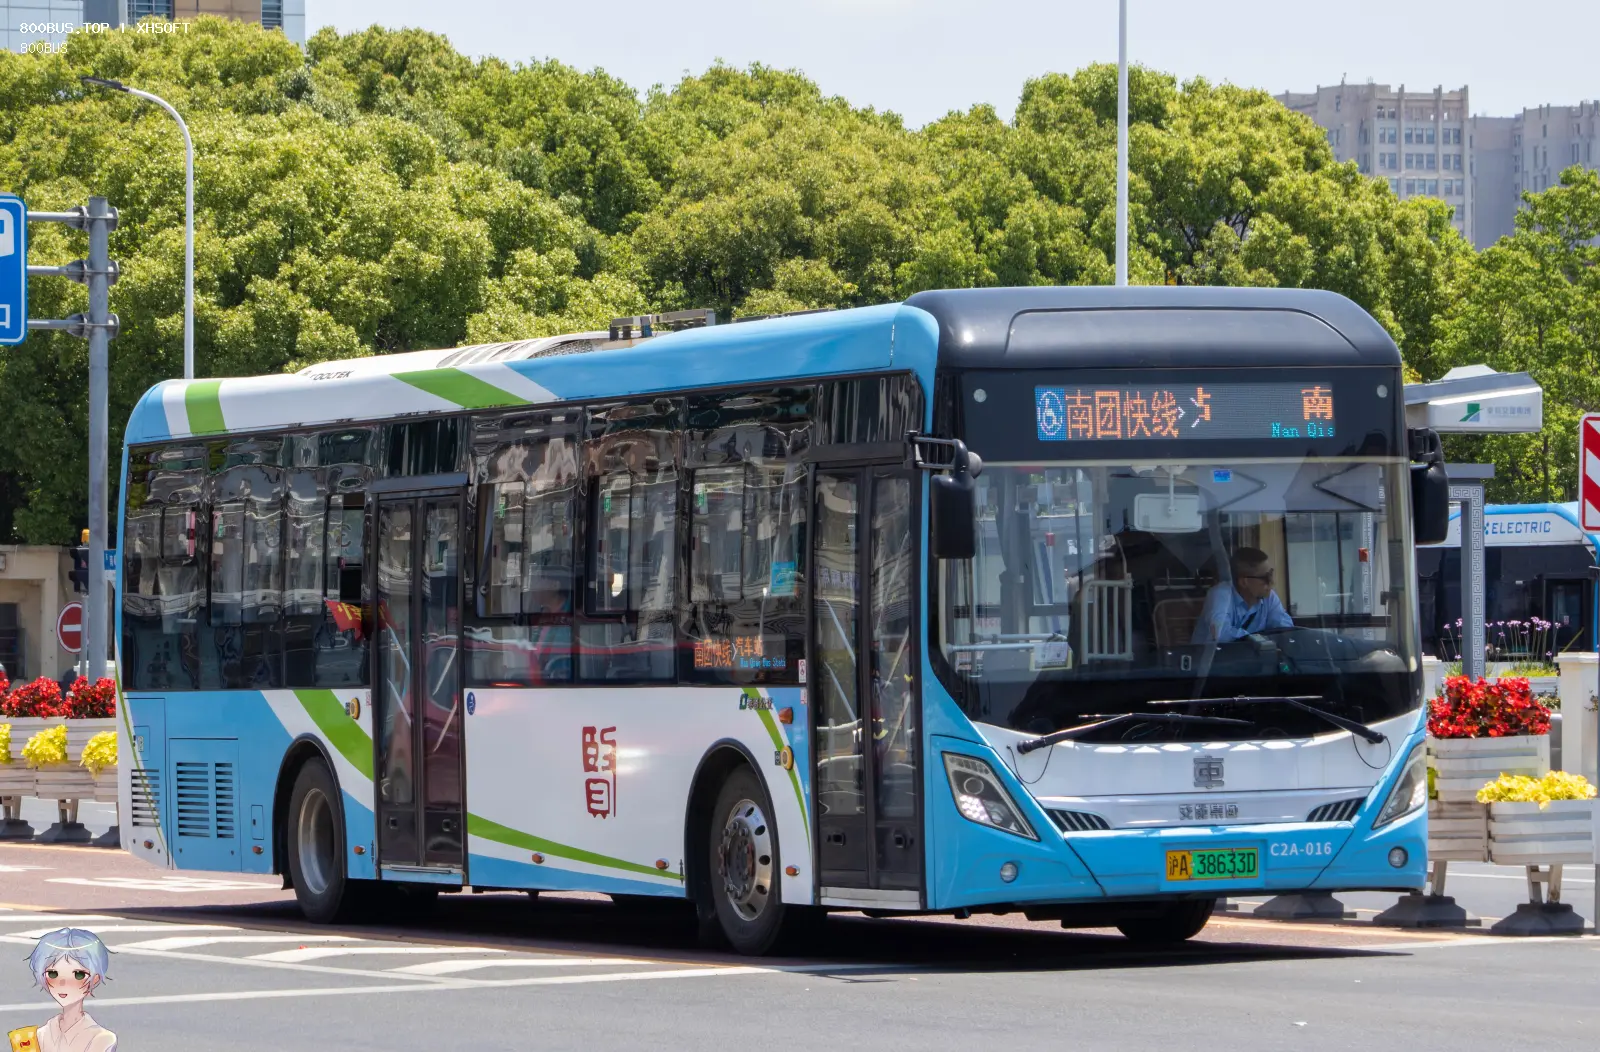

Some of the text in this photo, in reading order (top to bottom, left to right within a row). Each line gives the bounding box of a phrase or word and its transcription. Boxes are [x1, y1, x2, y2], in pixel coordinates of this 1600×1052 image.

[1066, 389, 1180, 439] 南团快线
[1271, 422, 1300, 437] Nan
[1491, 520, 1551, 534] ELECTRIC
[1270, 842, 1332, 856] C2A-016
